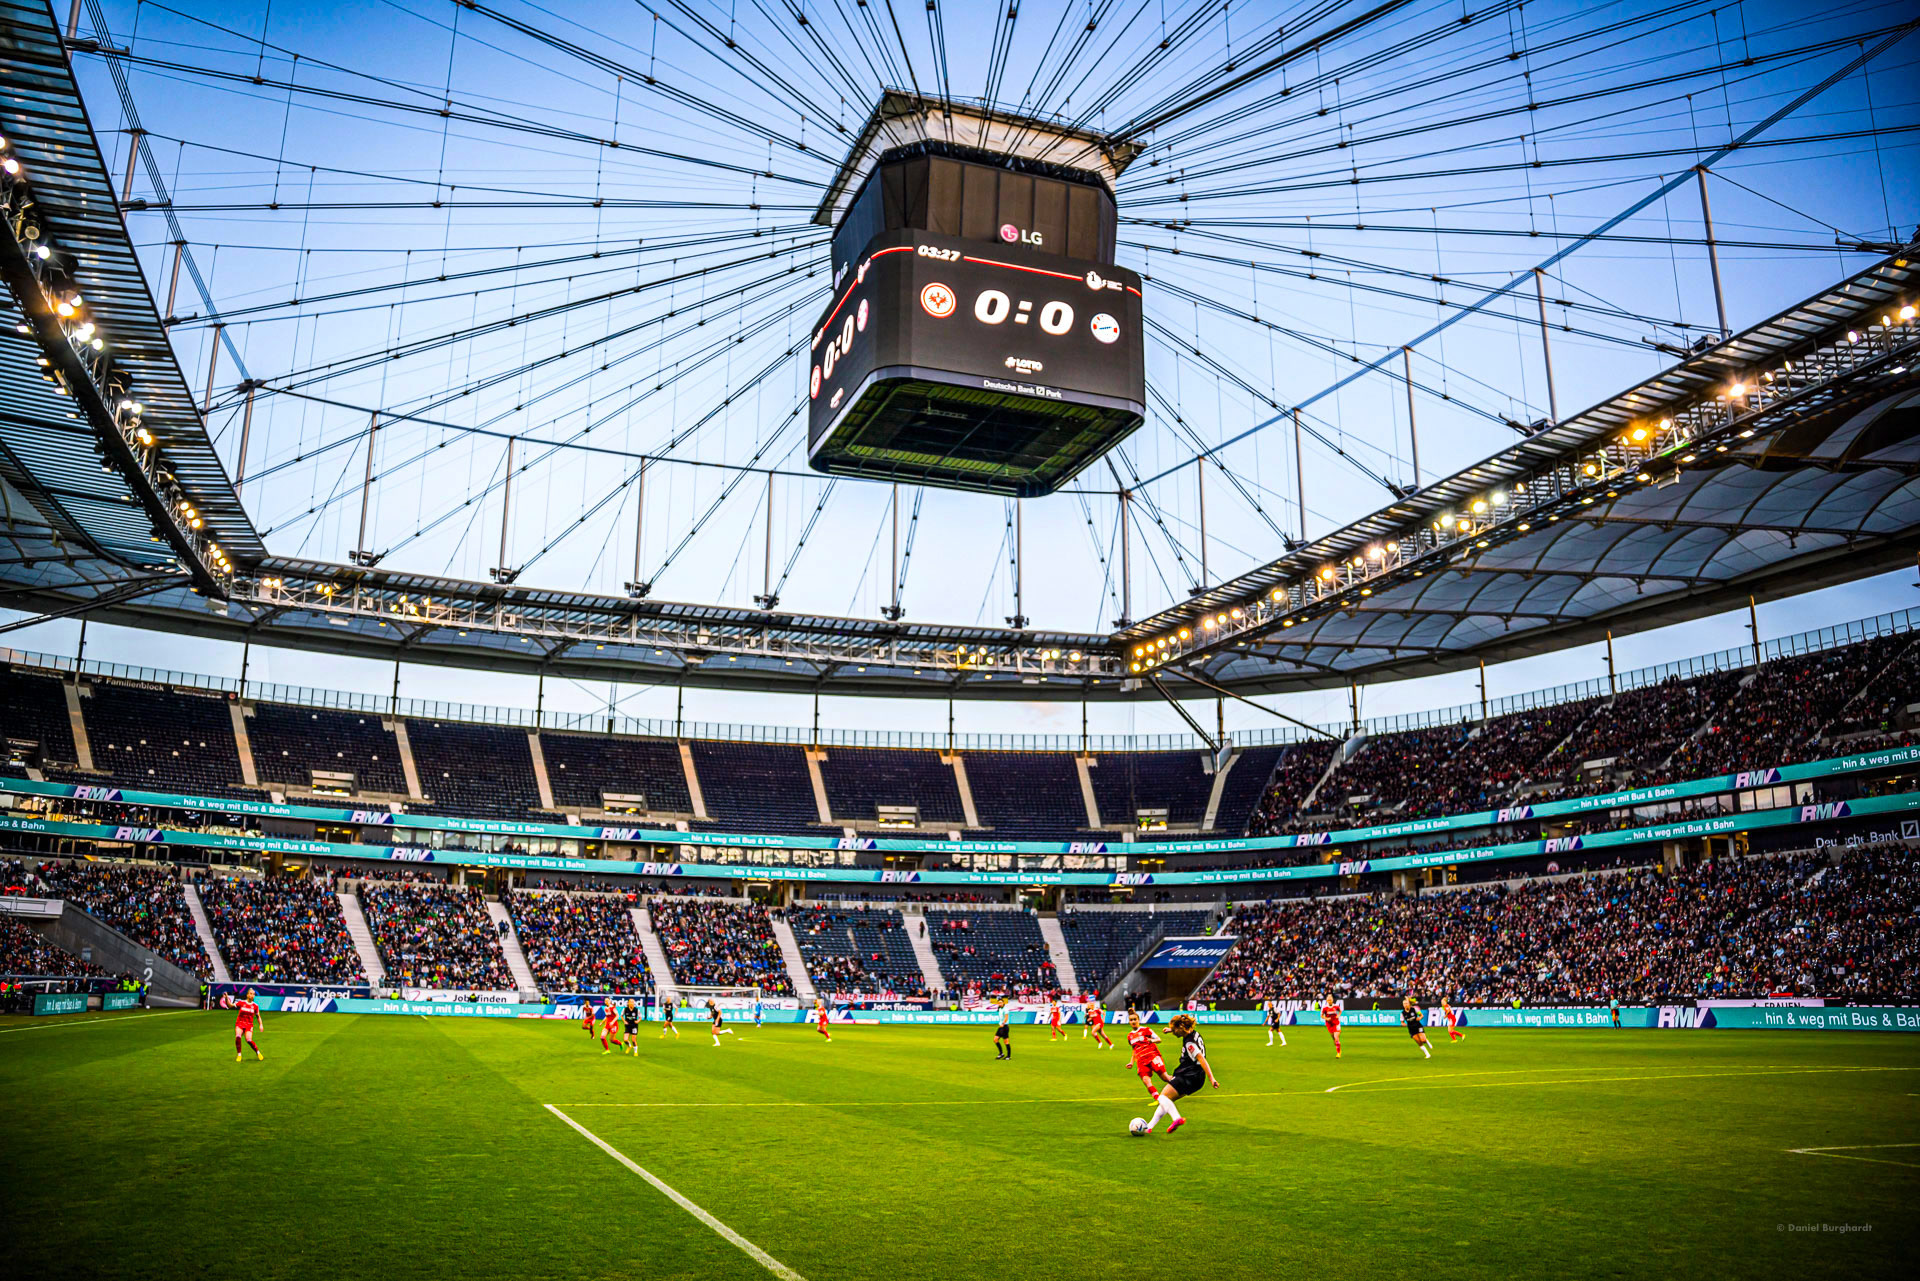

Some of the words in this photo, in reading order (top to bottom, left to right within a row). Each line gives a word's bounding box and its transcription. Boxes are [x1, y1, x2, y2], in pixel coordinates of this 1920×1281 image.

[1022, 229, 1042, 246] LG
[918, 244, 960, 262] 03:27
[974, 289, 1074, 336] 0:0
[984, 380, 1016, 391] Deutsche
[1018, 385, 1035, 393] Bank
[1046, 390, 1062, 398] Park
[1843, 760, 1857, 768] hin
[1869, 756, 1890, 765] weg
[1892, 750, 1908, 761] mit
[1736, 768, 1775, 788] RMV
[74, 786, 119, 800] RMV
[1601, 797, 1616, 806] weg
[1617, 794, 1630, 802] mit
[1631, 793, 1645, 801] Bus
[1655, 787, 1674, 797] Bahn
[183, 798, 196, 806] hin
[207, 802, 224, 811] weg
[227, 801, 240, 810] mit
[243, 802, 258, 812] Bus
[261, 804, 267, 812] &
[269, 805, 290, 814] Bahn
[1801, 802, 1846, 822] RMV
[351, 811, 390, 824] RMV
[1498, 806, 1529, 822] RMV
[21, 820, 45, 830] Bahn
[1634, 832, 1645, 840] hin
[1655, 829, 1671, 838] weg
[1673, 826, 1685, 834] mit
[1713, 820, 1734, 830] Bahn
[115, 827, 160, 841] RMV
[600, 827, 638, 840] RMV
[1296, 832, 1328, 846] RMV
[1816, 835, 1864, 848] Deuche
[1870, 830, 1898, 842] Bank
[248, 841, 265, 849] weg
[268, 841, 280, 849] mit
[283, 842, 298, 850] Bus
[309, 844, 330, 853] Bahn
[838, 838, 873, 849] RMV
[1069, 842, 1105, 853] RMV
[1545, 836, 1579, 853] RMV
[391, 847, 430, 861] RMV
[642, 863, 679, 874] RMV
[1339, 861, 1368, 874] RMV
[881, 871, 917, 882] RMV
[1115, 874, 1150, 884] RMV
[1172, 948, 1227, 956] mainova
[312, 989, 350, 999] indeed
[281, 997, 332, 1012] RMV
[412, 1006, 432, 1014] weg
[436, 1004, 451, 1013] mit
[455, 1005, 472, 1014] Bus
[486, 1006, 511, 1014] Bahn
[1034, 1011, 1073, 1024] RV
[1112, 1011, 1154, 1024] RV
[1503, 1014, 1514, 1023] hin
[1517, 1014, 1522, 1023] &
[1525, 1016, 1541, 1026] weg
[1544, 1014, 1556, 1023] mit
[1558, 1014, 1574, 1023] Bus
[1577, 1014, 1583, 1023] &
[1586, 1014, 1609, 1023] Bahn
[1658, 1008, 1709, 1027] RMV
[1765, 1012, 1783, 1024] hin
[1788, 1014, 1795, 1024] &
[1799, 1015, 1824, 1027] weg
[1829, 1013, 1848, 1025] mit
[1852, 1013, 1877, 1026] Bus
[1882, 1014, 1892, 1026] &
